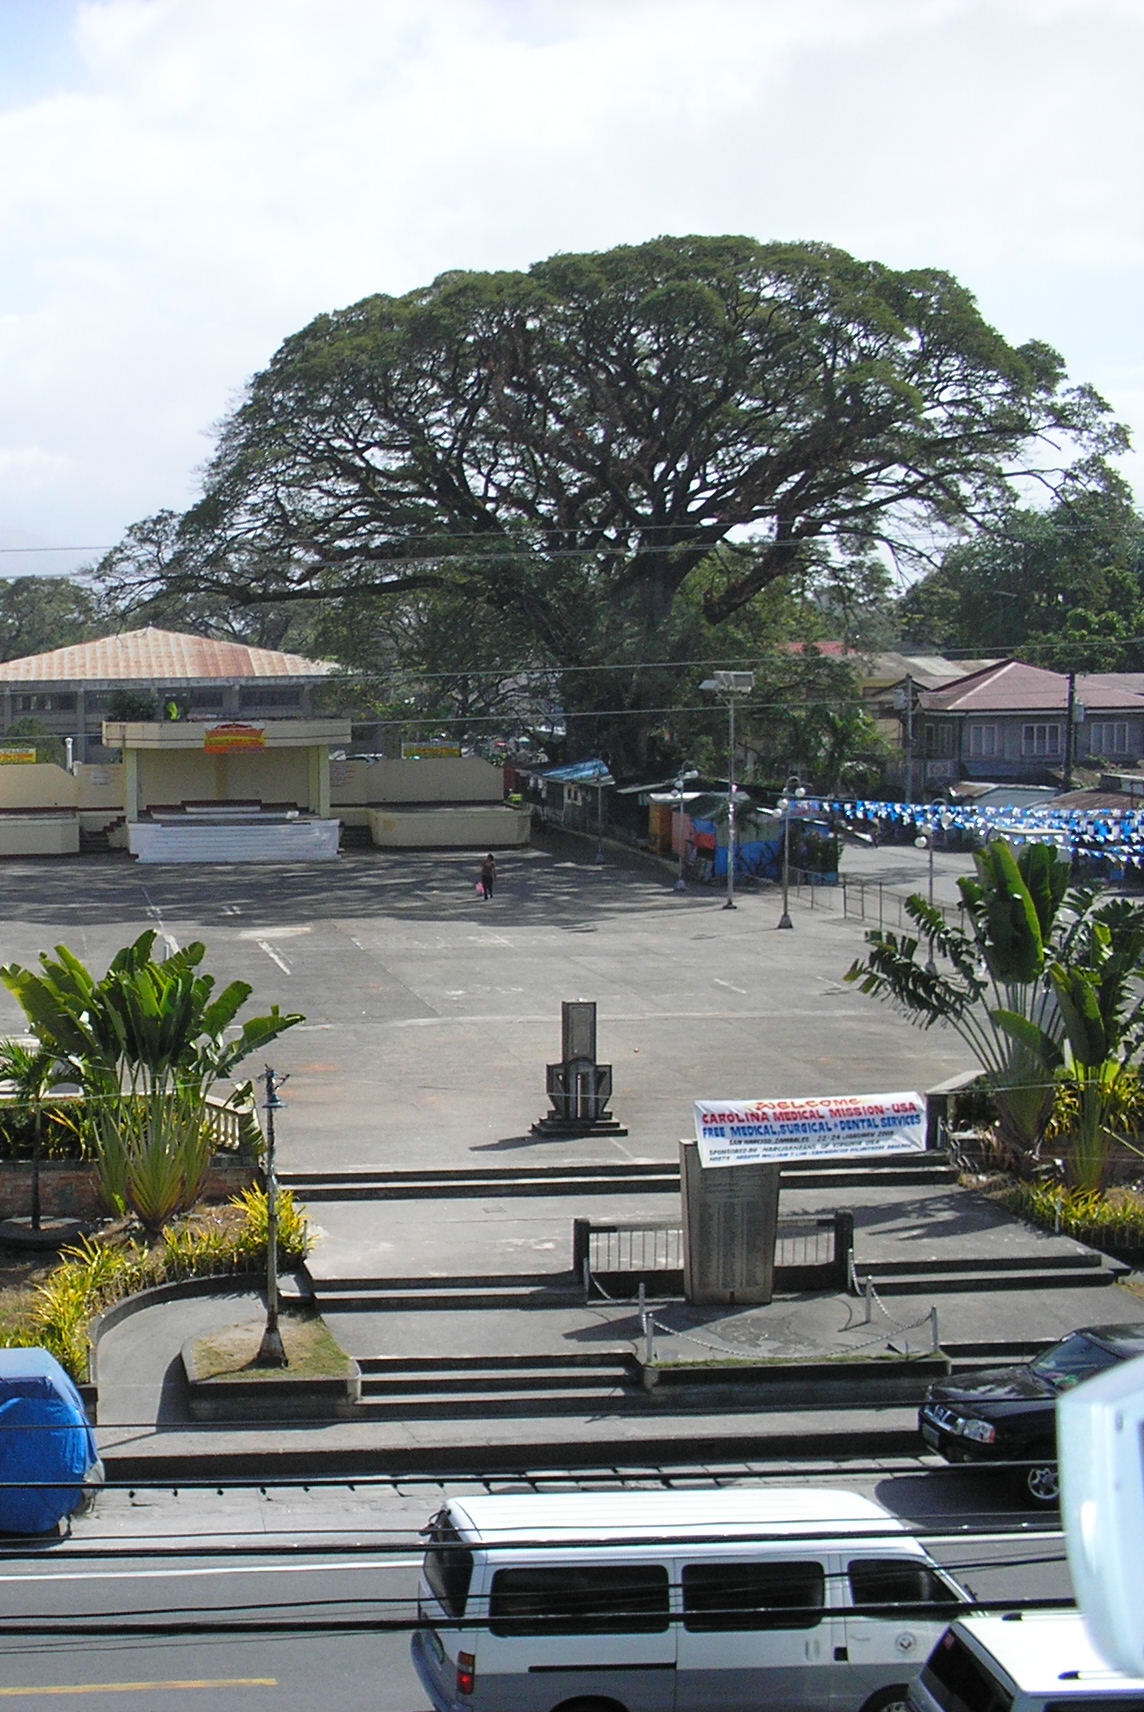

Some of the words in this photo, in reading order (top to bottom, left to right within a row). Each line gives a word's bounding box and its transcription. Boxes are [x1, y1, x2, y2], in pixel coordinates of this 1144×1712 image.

[756, 1098, 861, 1111] WELCOME
[702, 1111, 770, 1124] CAROLINA
[773, 1109, 825, 1122] MEDICAL
[702, 1126, 725, 1138] FREE
[840, 1118, 879, 1131] DENTAL
[881, 1114, 921, 1128] SERVICES
